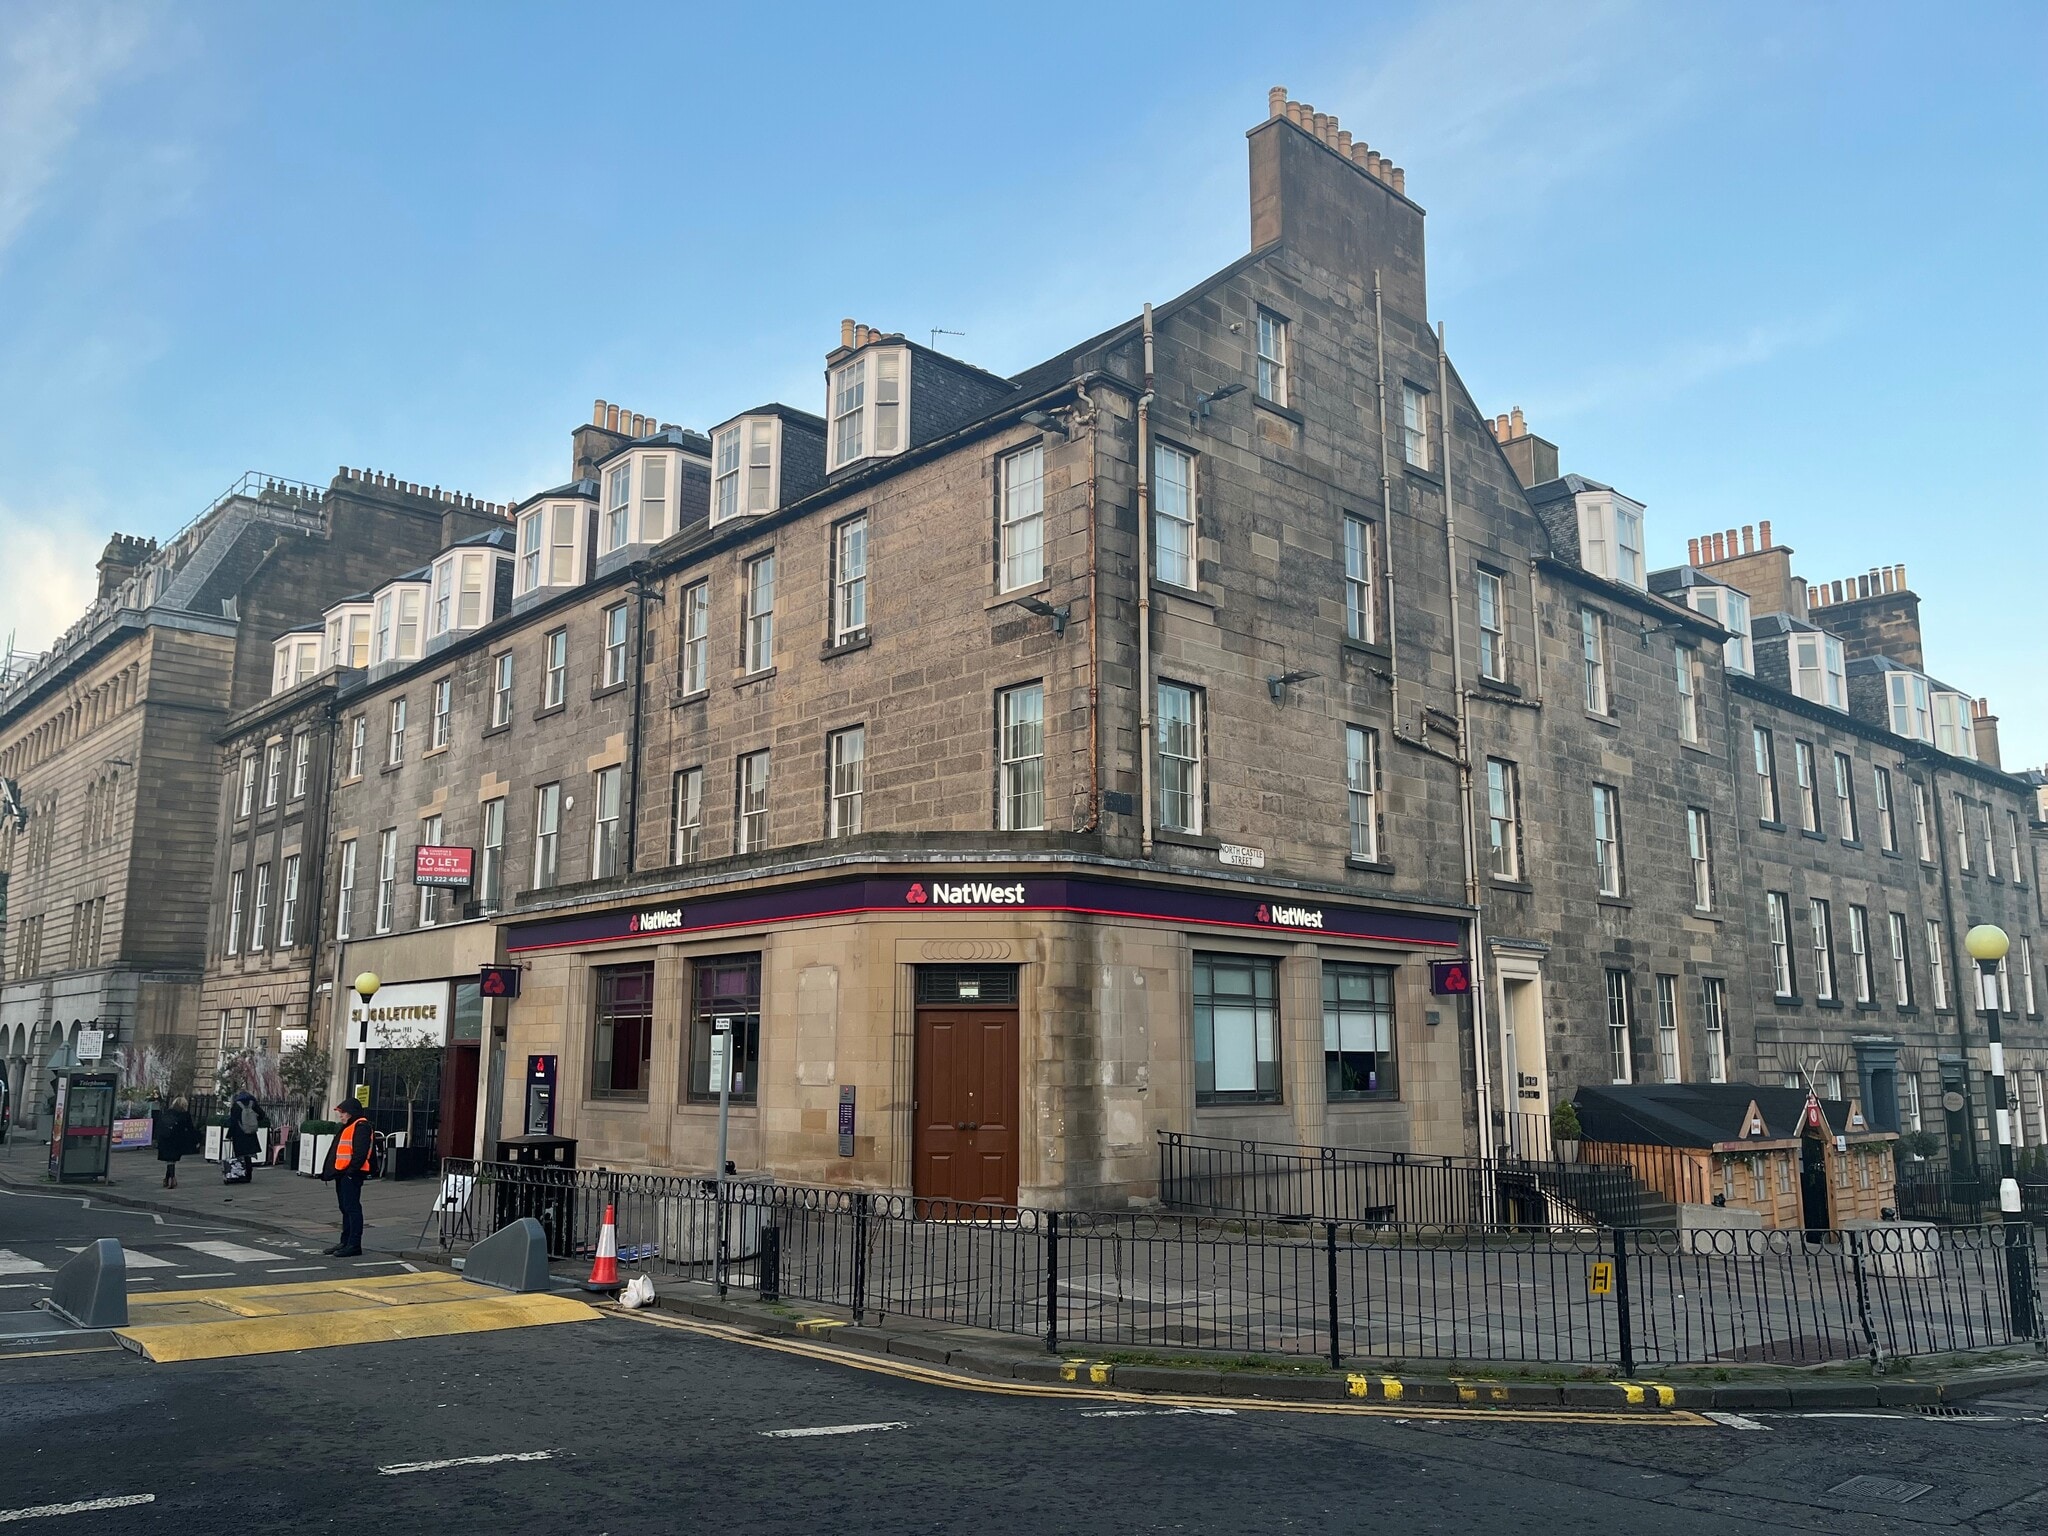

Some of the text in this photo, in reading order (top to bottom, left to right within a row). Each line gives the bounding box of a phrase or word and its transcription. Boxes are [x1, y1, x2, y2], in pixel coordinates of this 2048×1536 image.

[1221, 845, 1263, 859] NORTH CASTLE
[418, 857, 459, 867] TO LET
[1231, 856, 1253, 866] STREET
[933, 883, 1025, 904] NatWest
[640, 908, 682, 931] NatWest
[1271, 905, 1322, 928] NatWest
[352, 1008, 376, 1022] SLG
[1592, 1266, 1608, 1290] H
